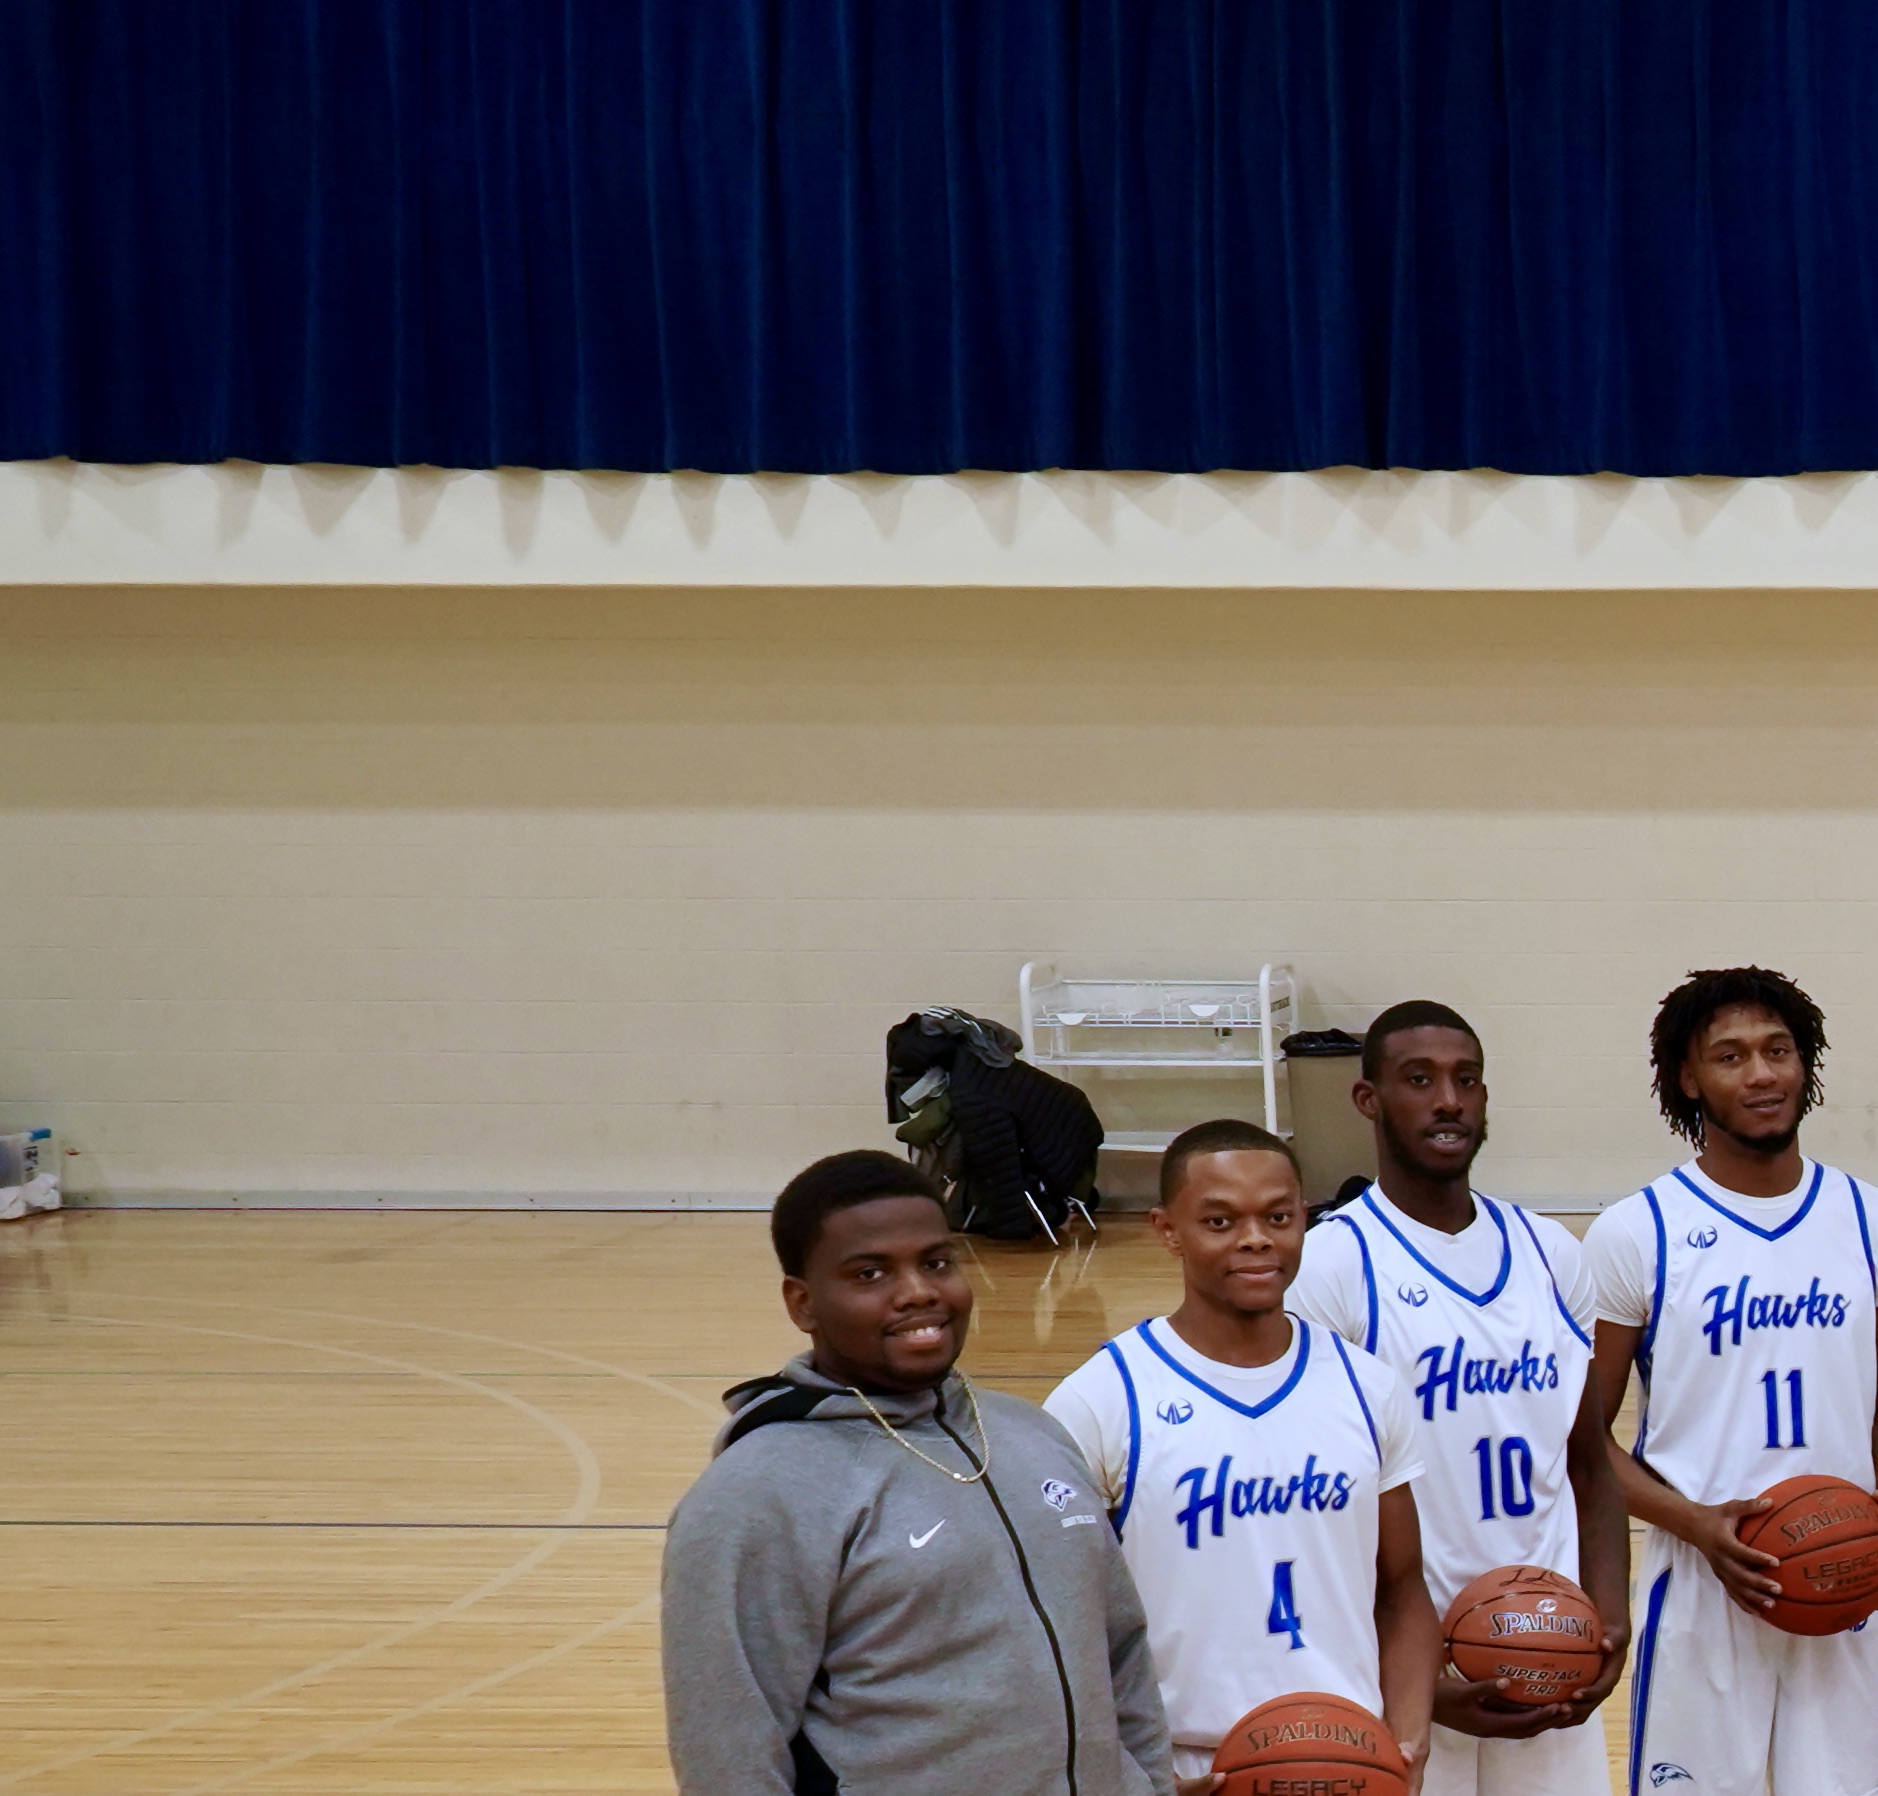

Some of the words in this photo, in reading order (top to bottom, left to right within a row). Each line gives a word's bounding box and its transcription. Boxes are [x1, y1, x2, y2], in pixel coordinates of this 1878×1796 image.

[1702, 1275, 1853, 1357] Hawks
[1415, 1336, 1562, 1422] Hawks
[1759, 1368, 1806, 1450] 11
[1176, 1454, 1357, 1551] Hawks
[1473, 1435, 1536, 1522] 10
[1266, 1560, 1306, 1651] 4
[1490, 1612, 1594, 1643] SPALDING
[1496, 1664, 1550, 1681] SUPER
[1523, 1684, 1561, 1696] PRO
[1246, 1721, 1377, 1756] SPALDING
